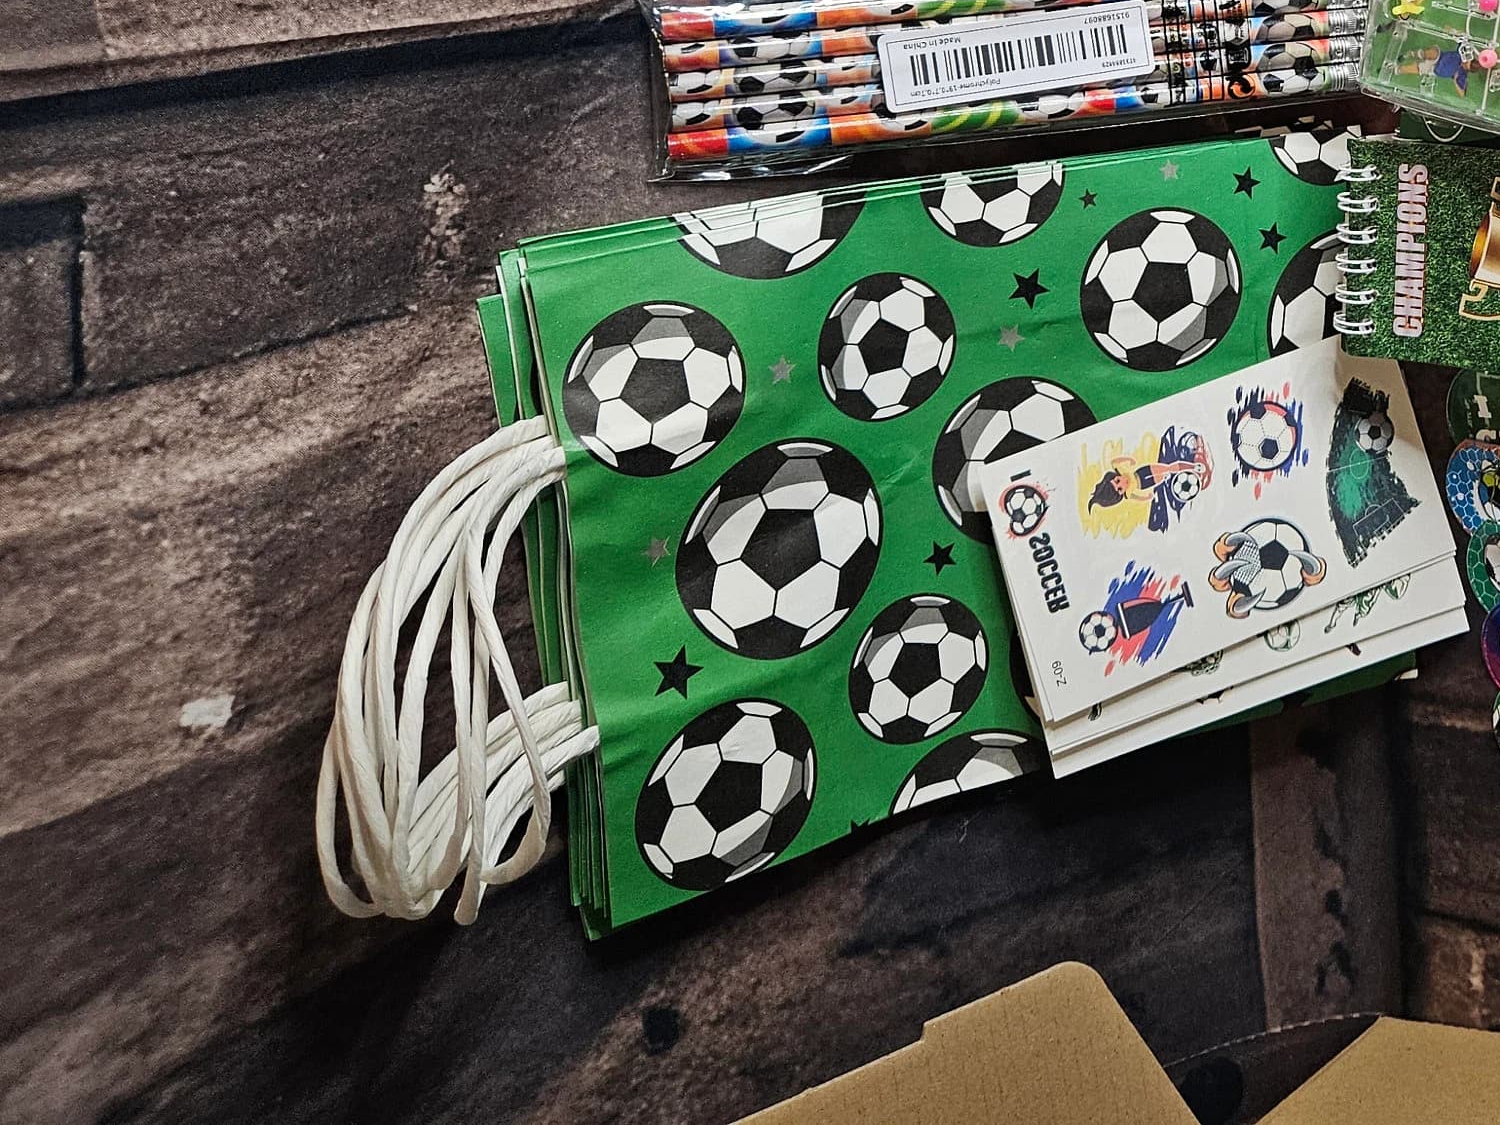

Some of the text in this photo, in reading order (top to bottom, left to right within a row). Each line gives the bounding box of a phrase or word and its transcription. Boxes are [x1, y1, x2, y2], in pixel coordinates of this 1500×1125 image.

[903, 40, 928, 50] China
[940, 36, 961, 45] Made
[1392, 162, 1429, 337] CHAMPIONS
[1474, 394, 1492, 419] I
[1050, 660, 1068, 687] Z-09
